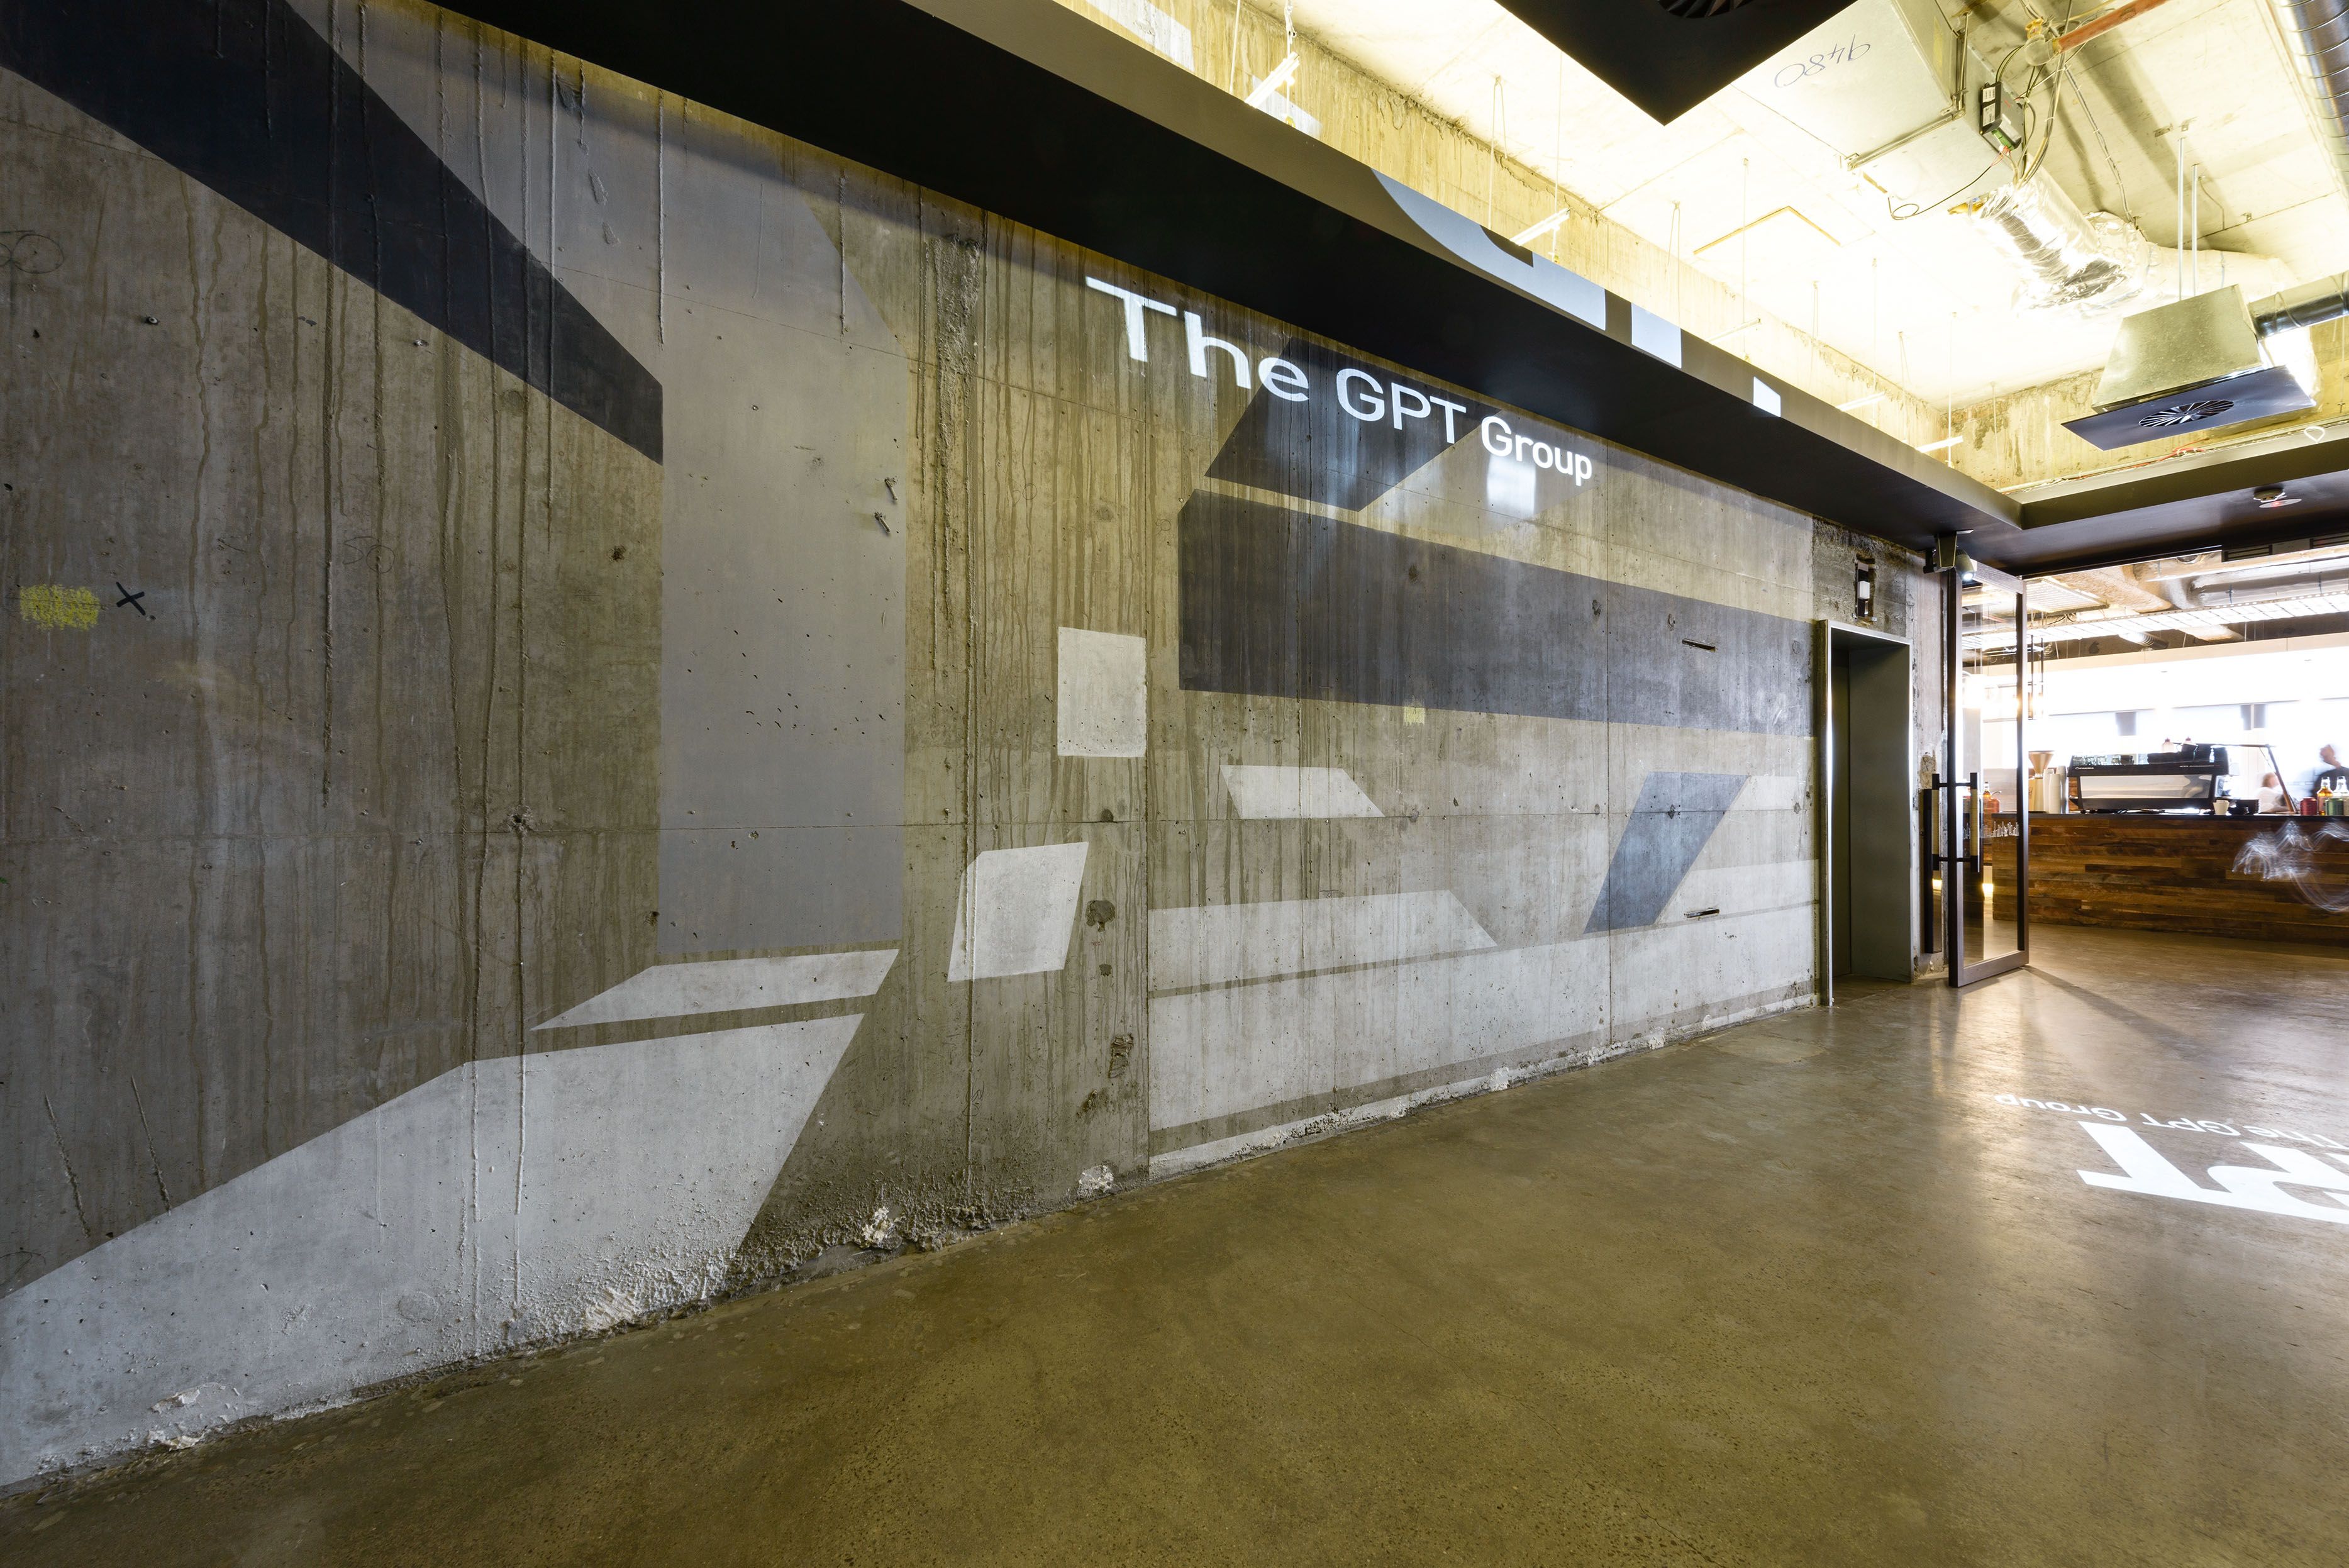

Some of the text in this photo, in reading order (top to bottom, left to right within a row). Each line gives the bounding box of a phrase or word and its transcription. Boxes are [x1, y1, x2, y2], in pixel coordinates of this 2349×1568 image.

[1774, 33, 1871, 88] 9480
[1086, 277, 1592, 486] The GPT Group
[1994, 1094, 2127, 1121] Group
[2140, 1113, 2241, 1136] GPT
[2077, 1121, 2349, 1225] PT
